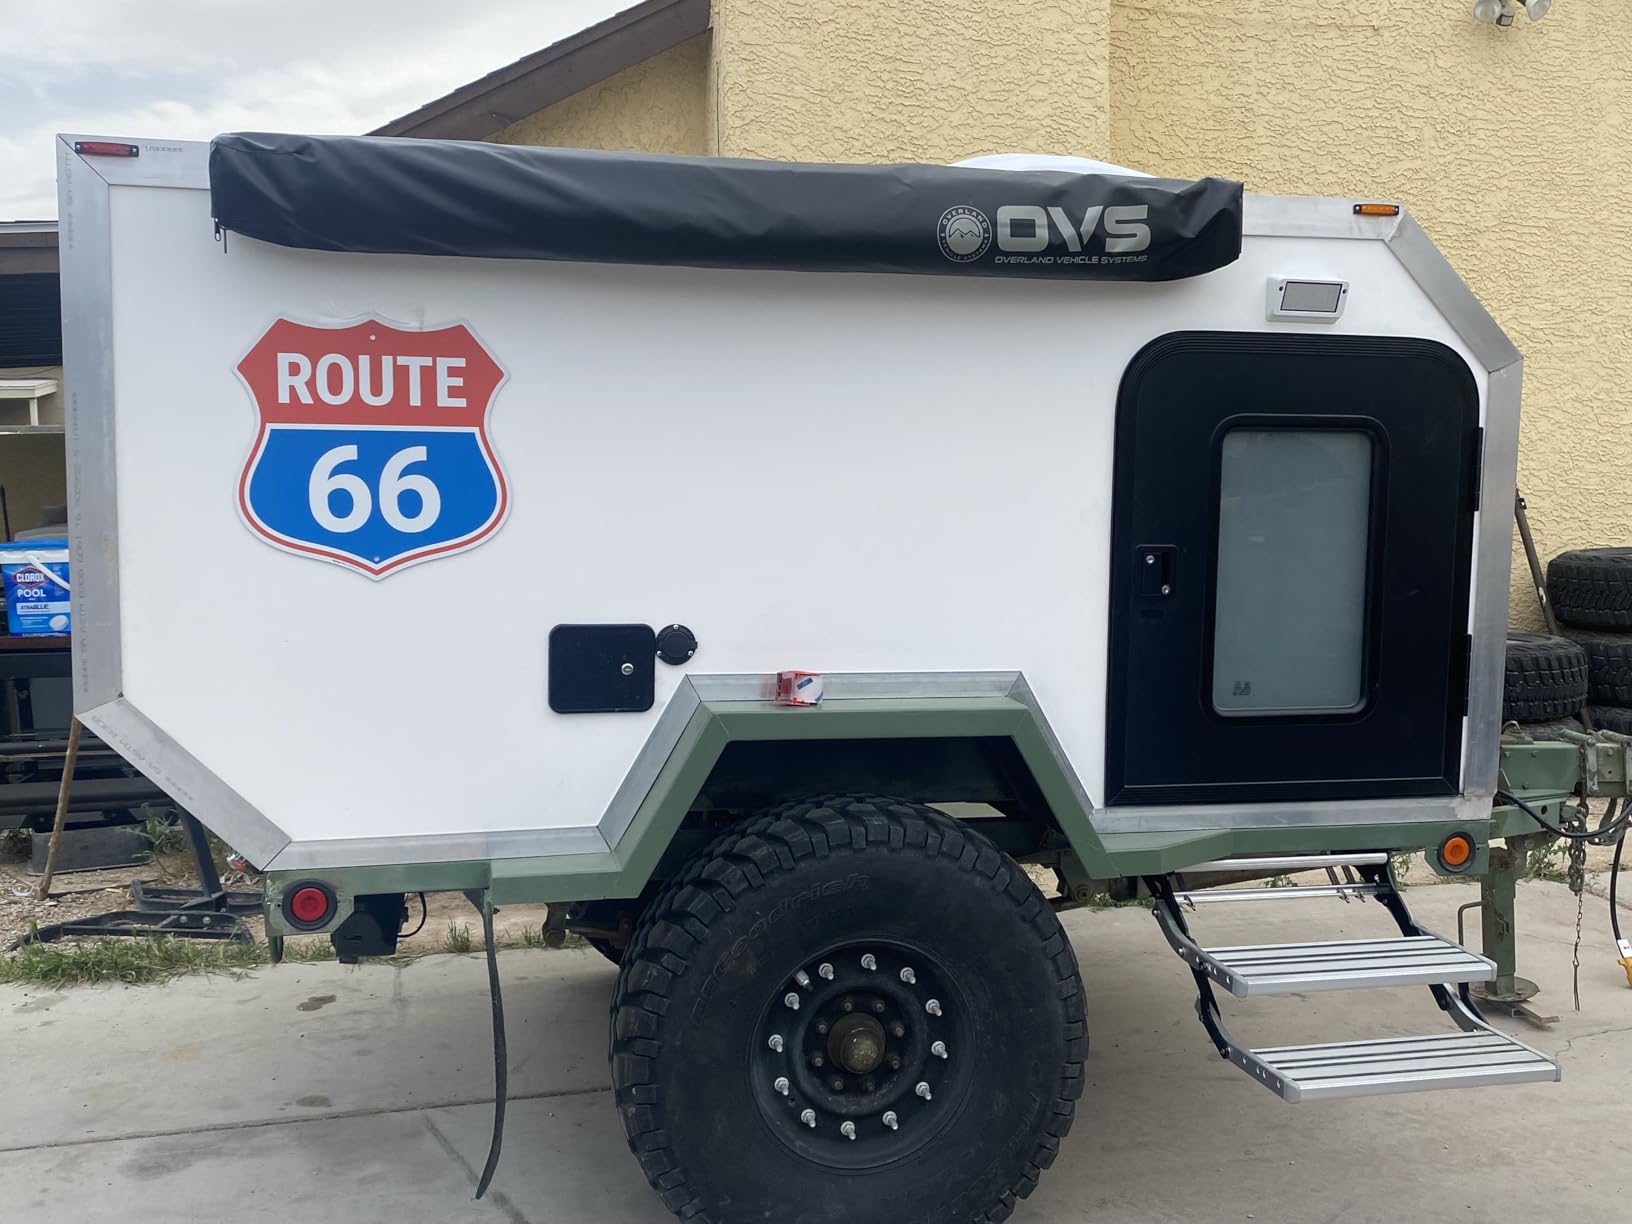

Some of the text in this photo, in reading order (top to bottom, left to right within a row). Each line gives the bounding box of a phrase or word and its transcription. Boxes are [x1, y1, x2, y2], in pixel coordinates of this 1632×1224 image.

[942, 208, 988, 229] OVERLAND
[996, 204, 1151, 252] OVS
[994, 254, 1149, 264] OVERLAND VEHICLE SYSTEMS
[276, 352, 468, 408] ROUTE
[308, 444, 442, 534] 66
[16, 572, 45, 583] CLOROX
[17, 588, 47, 598] POOL
